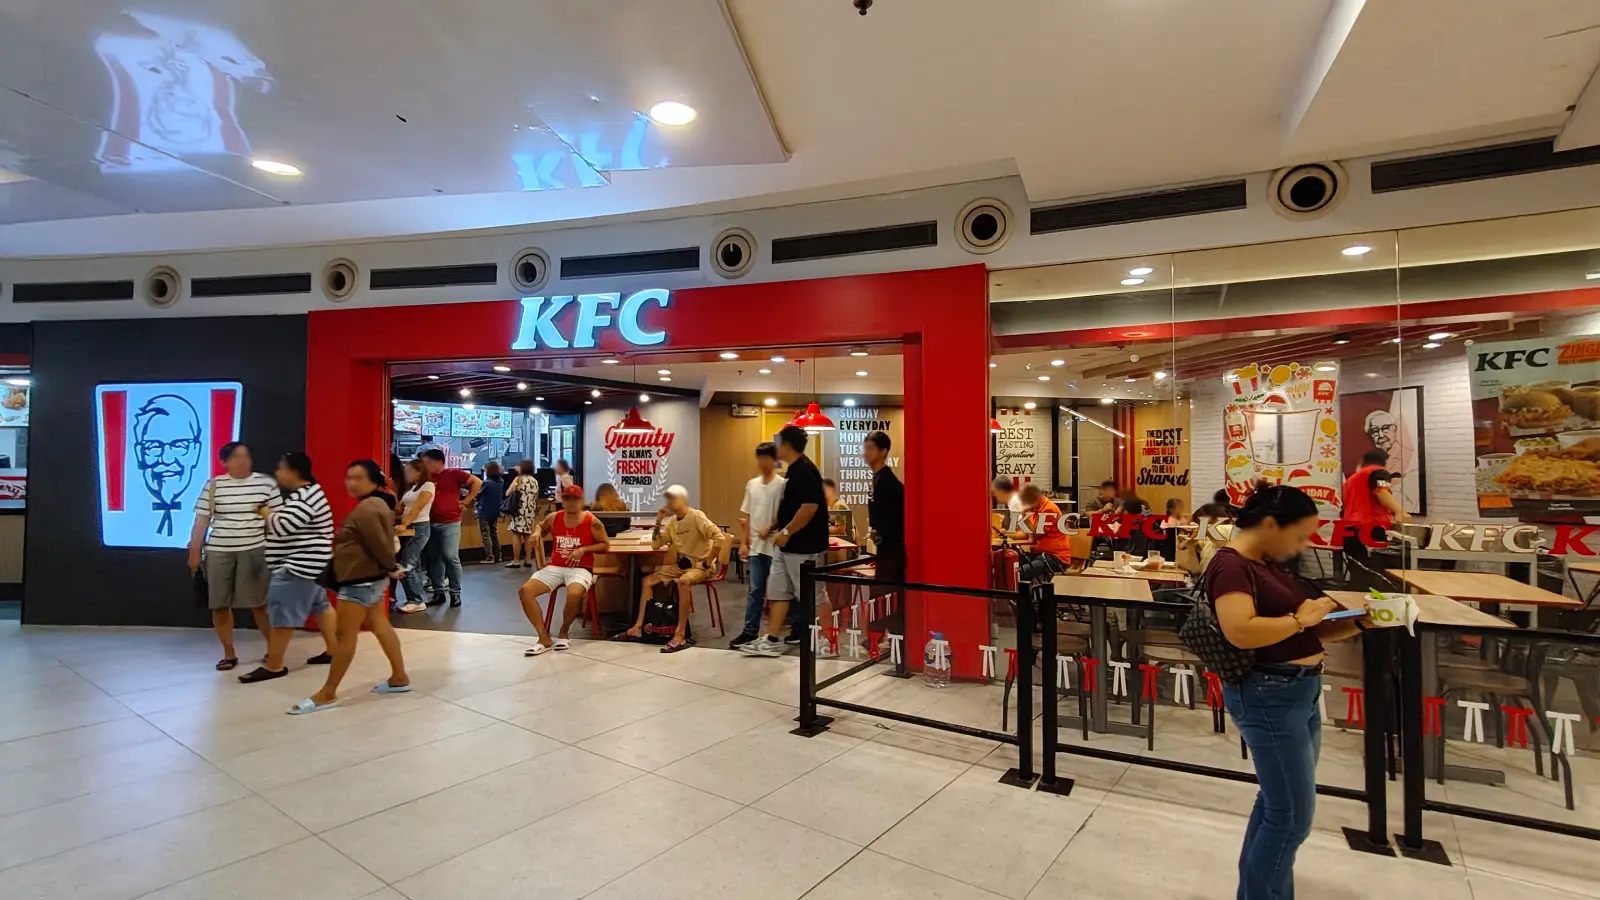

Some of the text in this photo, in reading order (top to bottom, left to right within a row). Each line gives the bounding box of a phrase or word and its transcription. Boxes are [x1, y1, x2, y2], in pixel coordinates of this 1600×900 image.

[511, 288, 670, 350] KFC
[1474, 348, 1550, 372] KFC
[840, 408, 879, 419] SUNDAY
[839, 420, 891, 431] EVERYDAY
[840, 432, 868, 443] MOND
[998, 427, 1034, 440] BEST
[1155, 427, 1183, 447] BEST
[998, 440, 1035, 449] TASTING
[621, 449, 653, 459] IS ALWAYS
[996, 448, 1035, 463] Signature
[616, 459, 659, 475] FRESHLY
[995, 463, 1037, 475] GRAVY
[620, 475, 653, 486] PREPARED
[839, 469, 874, 480] THURS
[1136, 467, 1190, 487] Shared
[1006, 511, 1080, 536] KFC
[1087, 513, 1169, 539] KFC
[1424, 522, 1539, 553] KFC
